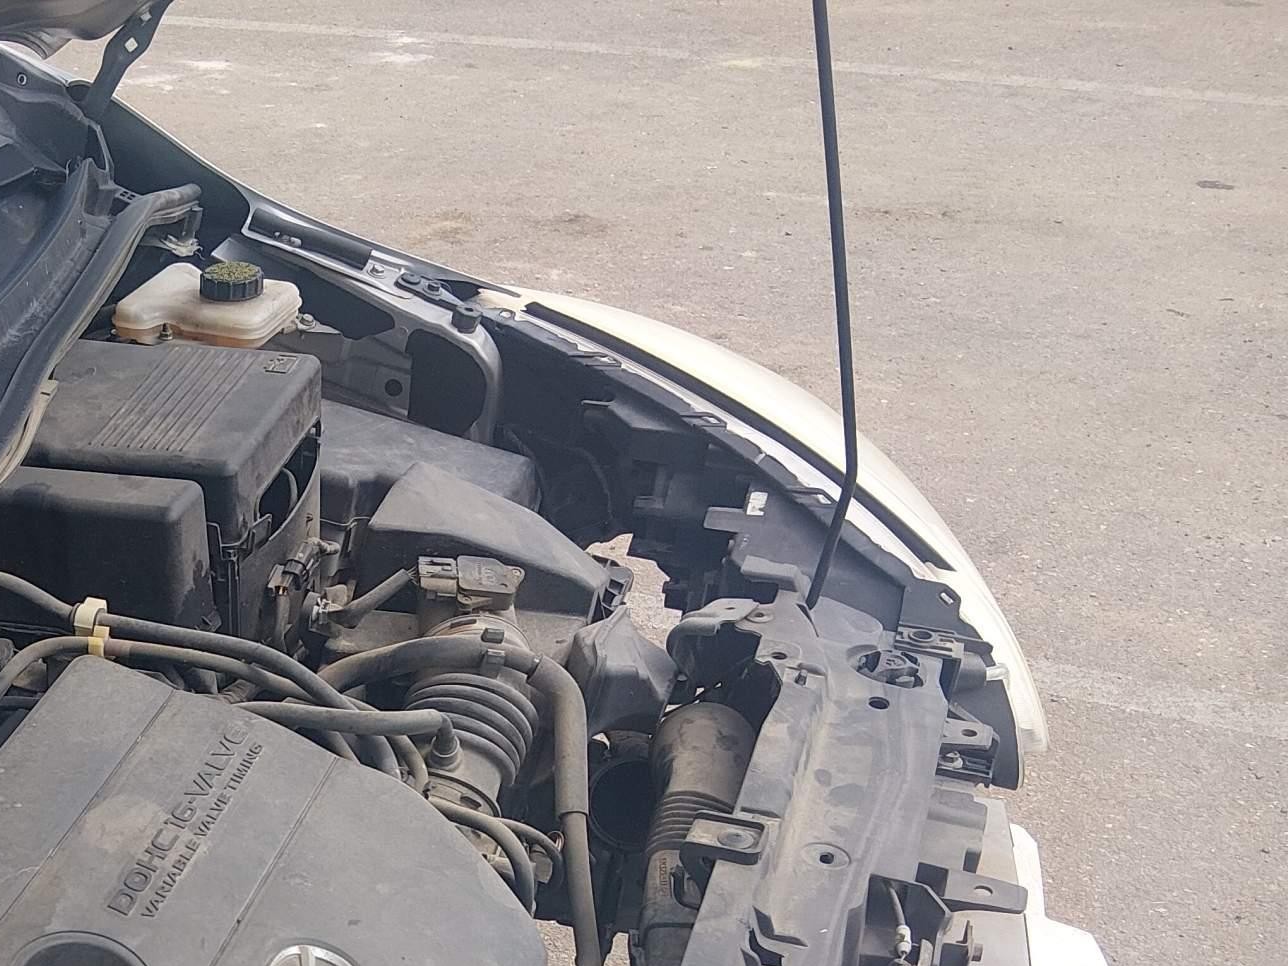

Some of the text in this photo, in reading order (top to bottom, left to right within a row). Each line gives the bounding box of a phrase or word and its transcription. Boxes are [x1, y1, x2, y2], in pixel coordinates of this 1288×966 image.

[107, 827, 180, 917] DOHC
[140, 742, 263, 918] VARIABLE VALVE TIMING
